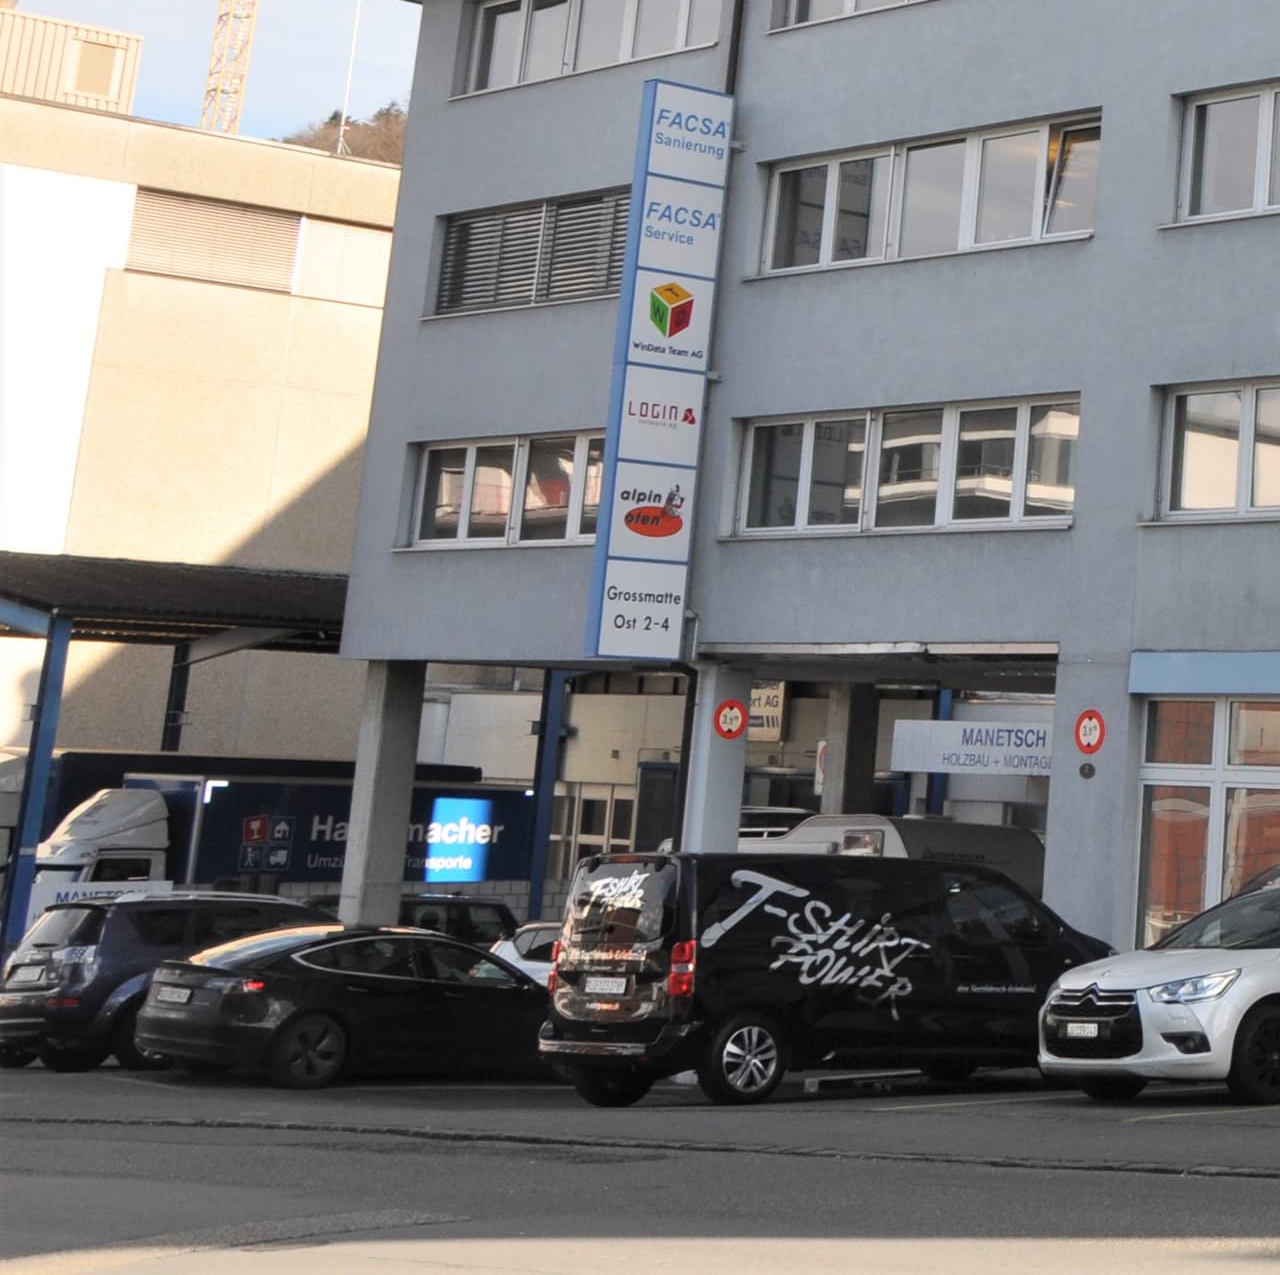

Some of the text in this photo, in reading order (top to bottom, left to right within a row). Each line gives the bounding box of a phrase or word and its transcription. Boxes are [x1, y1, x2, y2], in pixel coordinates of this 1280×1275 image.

[656, 108, 726, 139] FACSA
[655, 132, 725, 160] Sanierung
[646, 201, 716, 231] FACSA
[644, 225, 695, 246] Service
[632, 340, 704, 360] WinData Team AG
[620, 488, 662, 505] alpin
[607, 584, 682, 605] Grossmatte
[613, 613, 670, 632] Ost 2-4
[763, 694, 780, 708] AG
[961, 727, 1047, 748] MANETSCH
[942, 752, 990, 767] HOLZBAU
